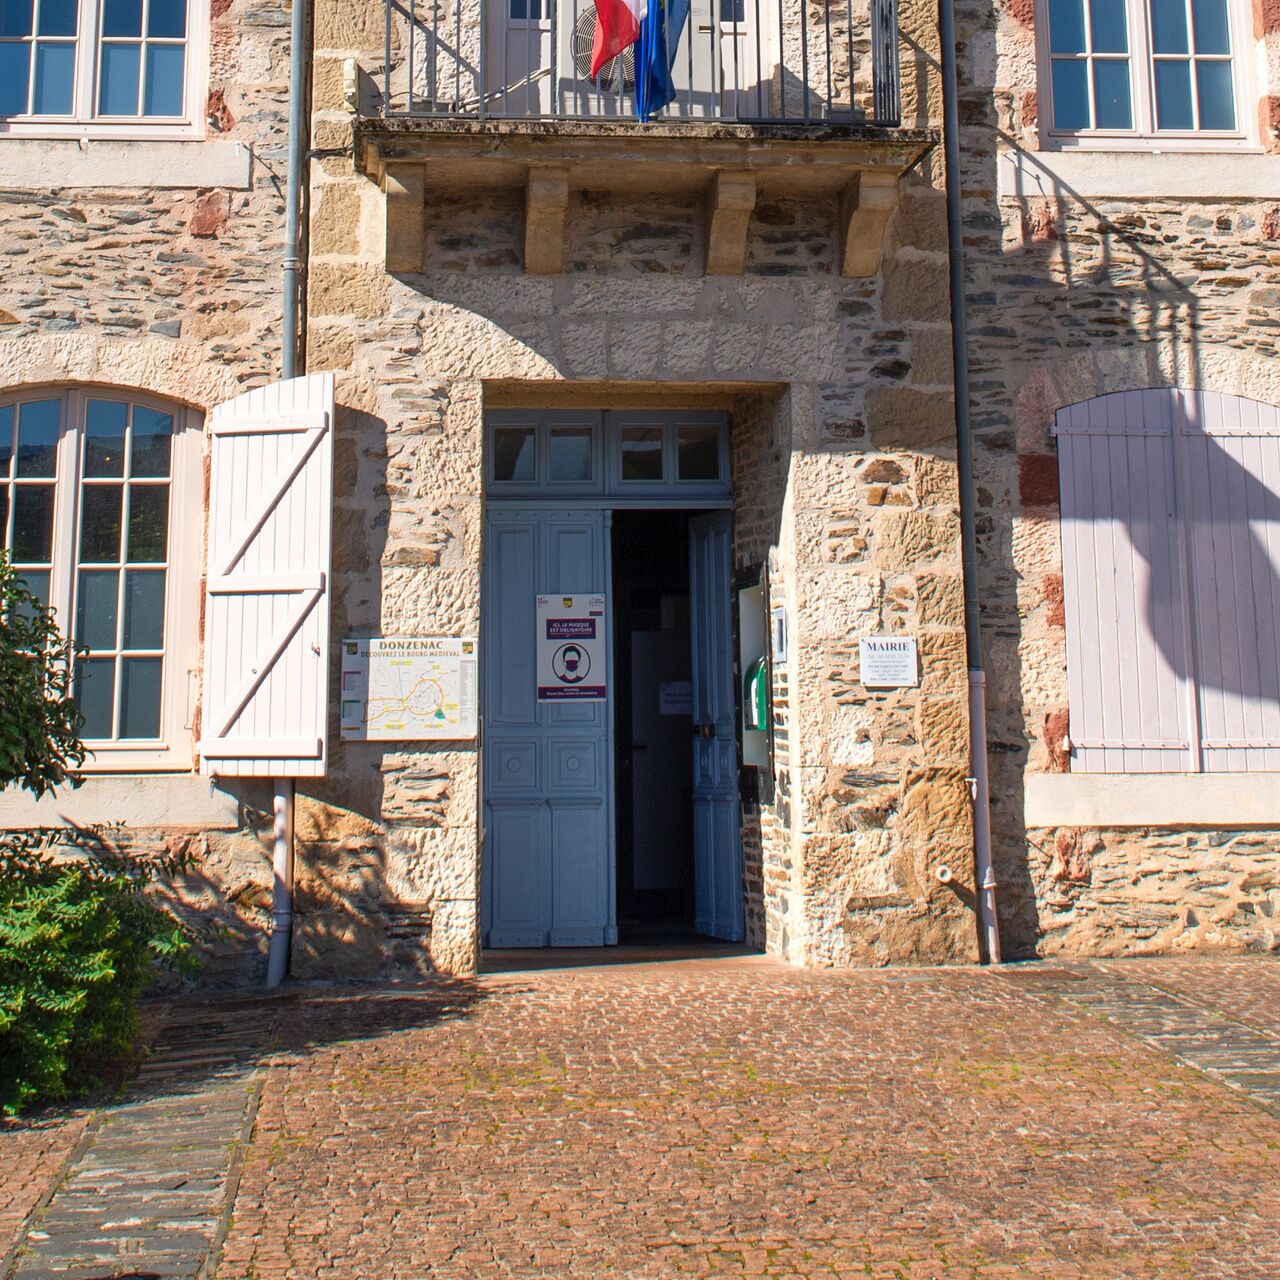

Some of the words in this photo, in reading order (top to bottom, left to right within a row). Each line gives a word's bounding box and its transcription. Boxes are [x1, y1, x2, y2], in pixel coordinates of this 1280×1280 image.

[380, 641, 443, 650] DONZENAC
[867, 642, 910, 651] MAIRIE
[399, 650, 406, 658] LE
[407, 650, 428, 658] BOURG
